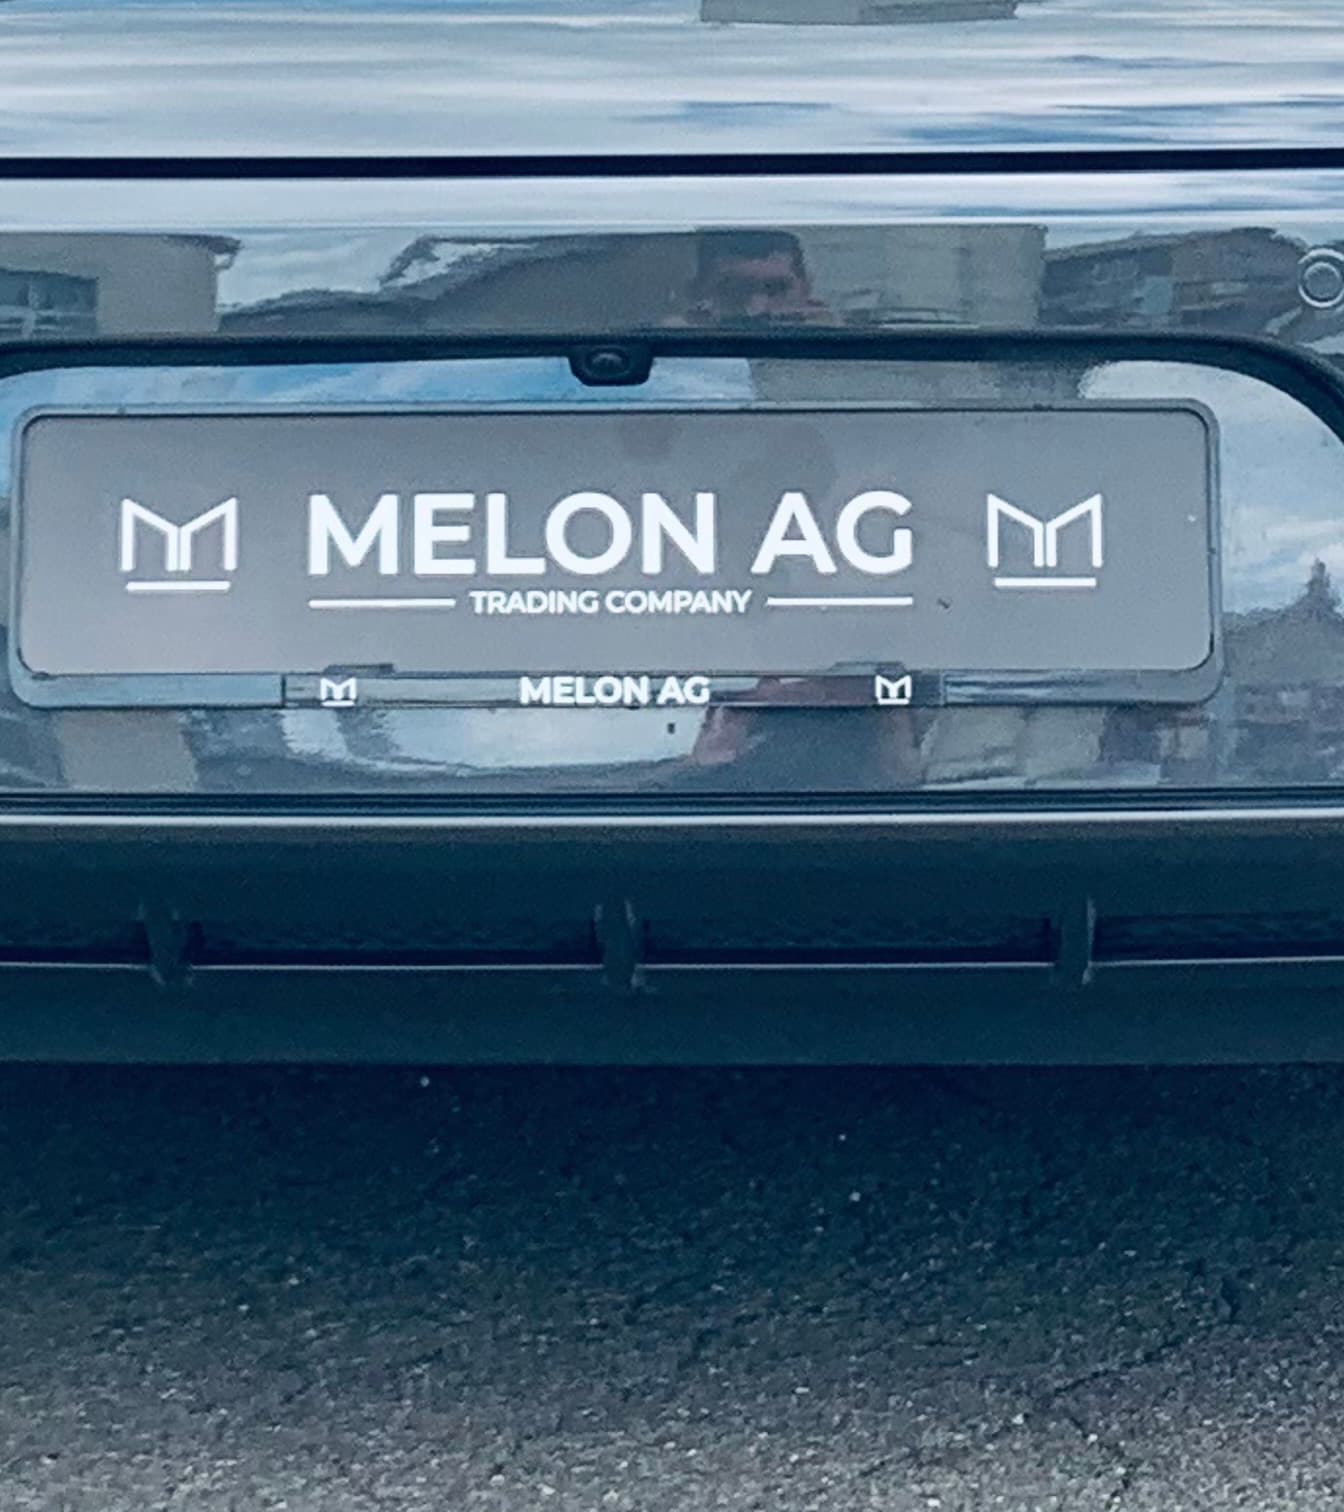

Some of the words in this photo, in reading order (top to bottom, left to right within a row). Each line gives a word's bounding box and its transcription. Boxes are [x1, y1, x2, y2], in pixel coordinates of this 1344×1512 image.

[307, 491, 716, 576] MELON
[750, 490, 913, 575] AG
[468, 590, 600, 615] TRADING
[604, 588, 753, 615] COMPANY
[518, 675, 651, 705] MELON
[656, 675, 711, 705] AG
